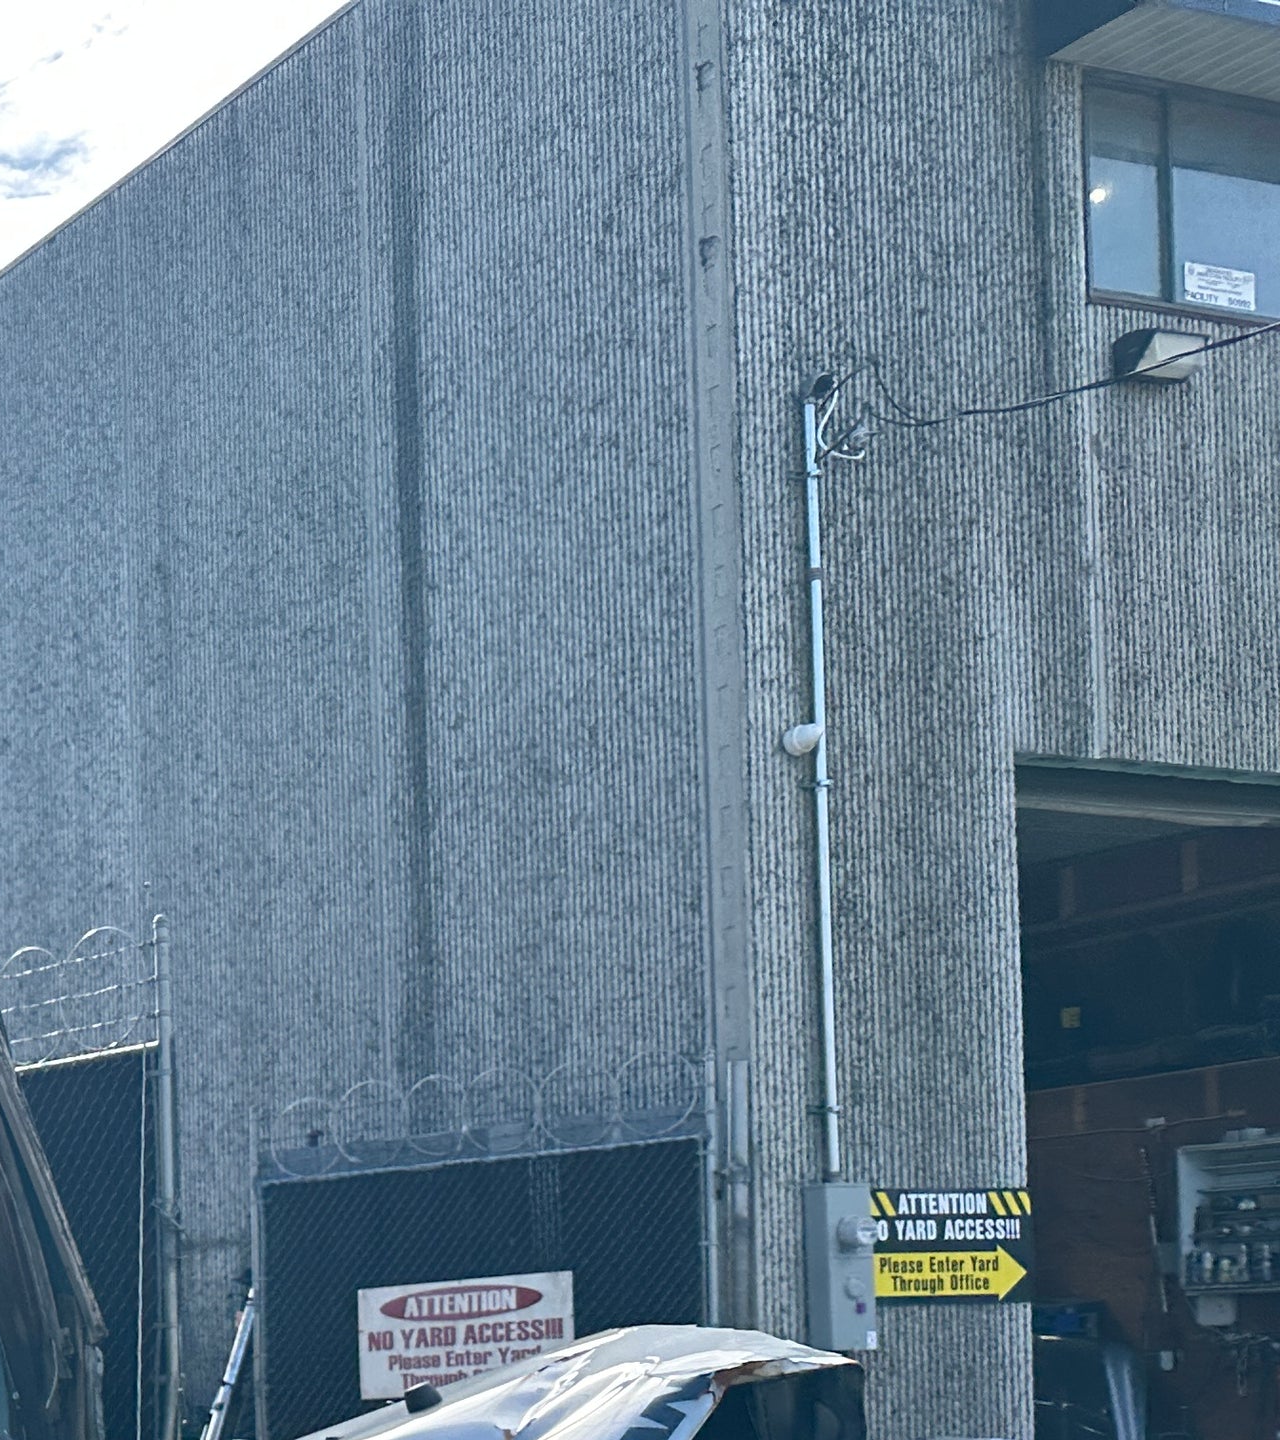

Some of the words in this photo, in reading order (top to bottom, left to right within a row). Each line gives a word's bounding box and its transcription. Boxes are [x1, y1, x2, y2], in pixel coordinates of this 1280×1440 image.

[898, 1192, 988, 1216] ATTENTION
[895, 1219, 938, 1241] YARD
[944, 1218, 1021, 1241] ACCESS!!!
[879, 1256, 923, 1274] Please
[929, 1256, 964, 1273] Enter
[971, 1255, 999, 1272] Yard
[892, 1275, 944, 1294] Through
[950, 1274, 990, 1291] Office
[403, 1287, 518, 1318] ATTENTION
[368, 1329, 394, 1352] NO
[400, 1325, 456, 1349] YARD
[463, 1317, 564, 1344] ACCESS!!!
[388, 1353, 441, 1371] Please
[445, 1349, 493, 1367] Enter
